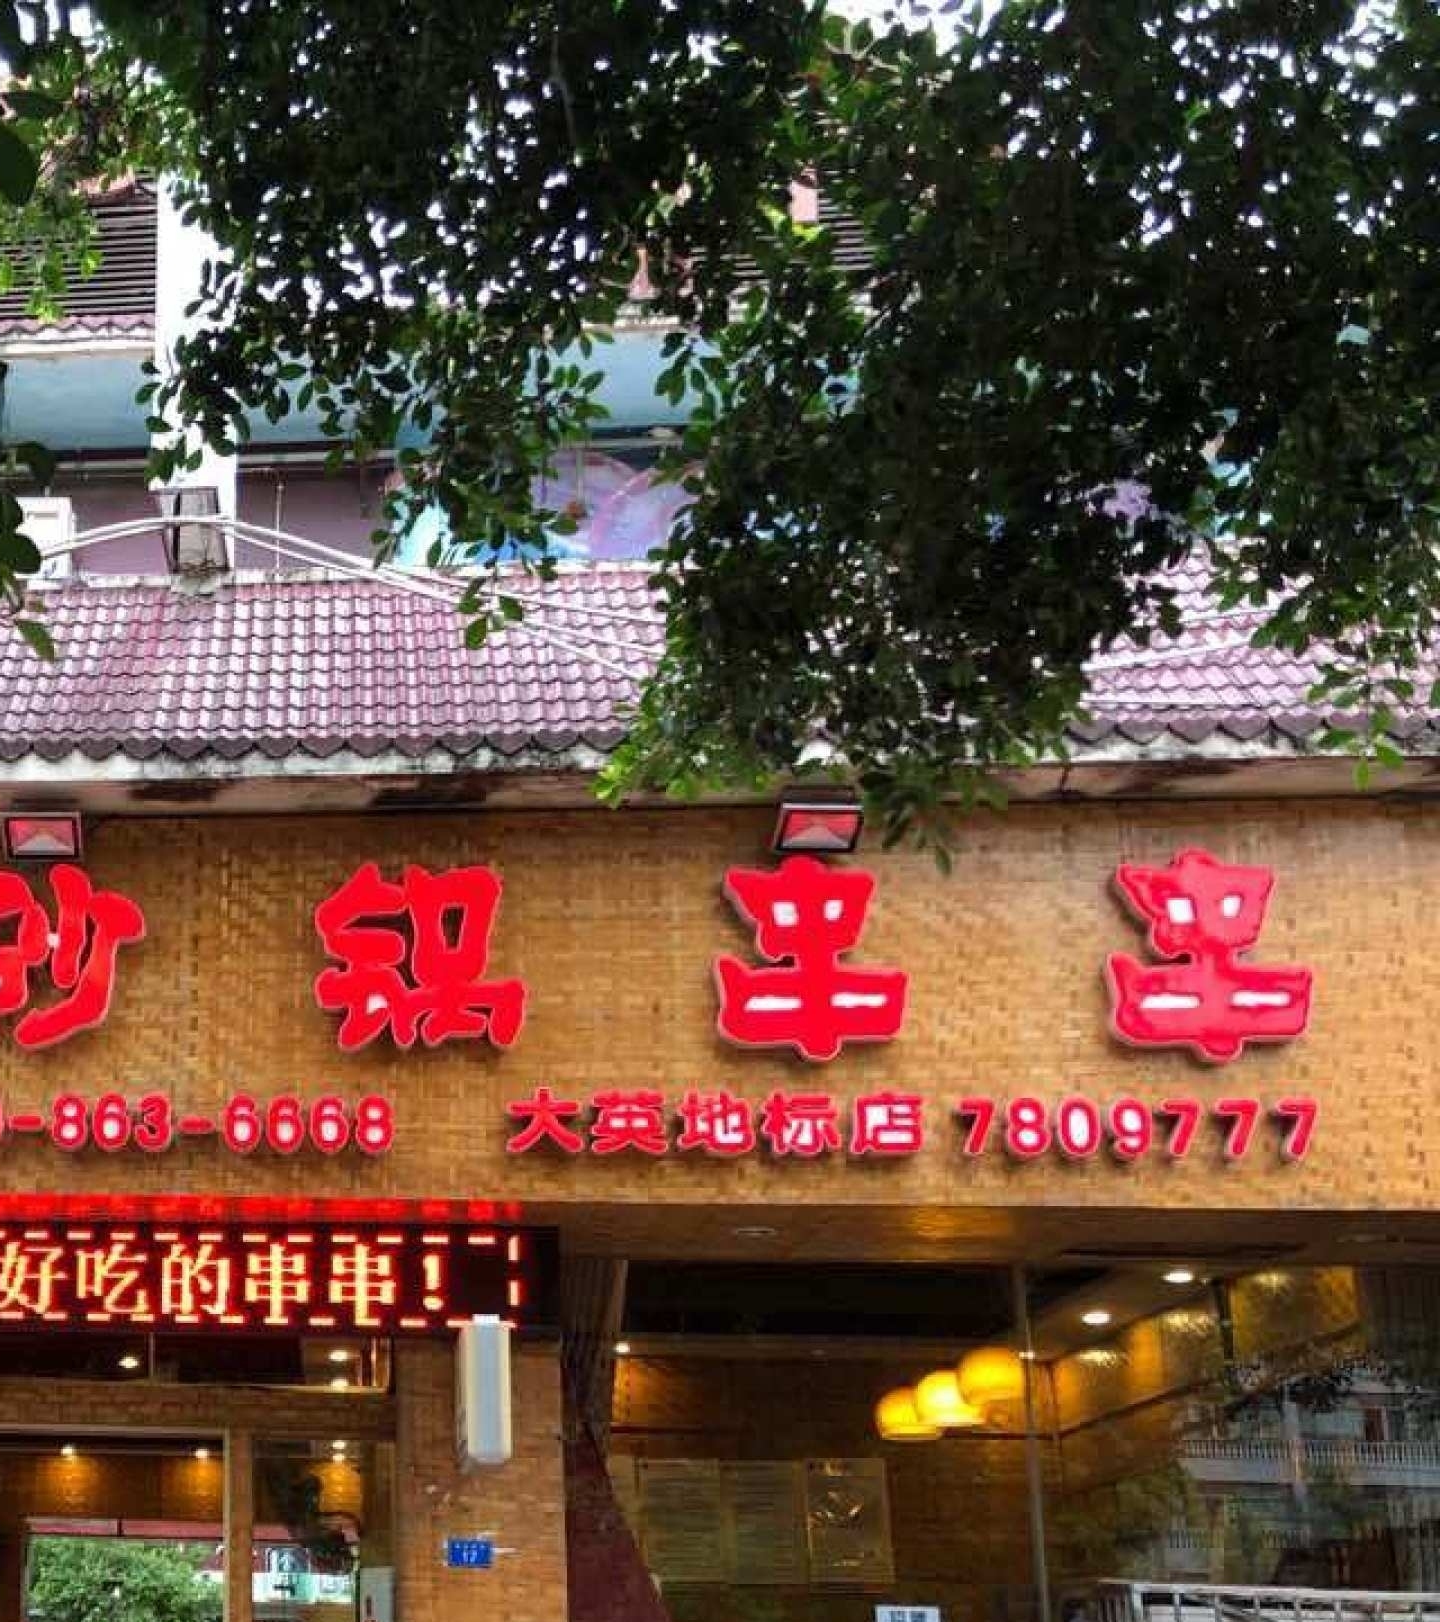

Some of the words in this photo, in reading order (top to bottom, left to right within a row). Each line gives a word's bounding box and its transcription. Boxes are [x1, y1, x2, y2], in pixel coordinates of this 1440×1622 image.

[506, 1087, 925, 1156] 大英地标店
[957, 1095, 1321, 1162] 7809777
